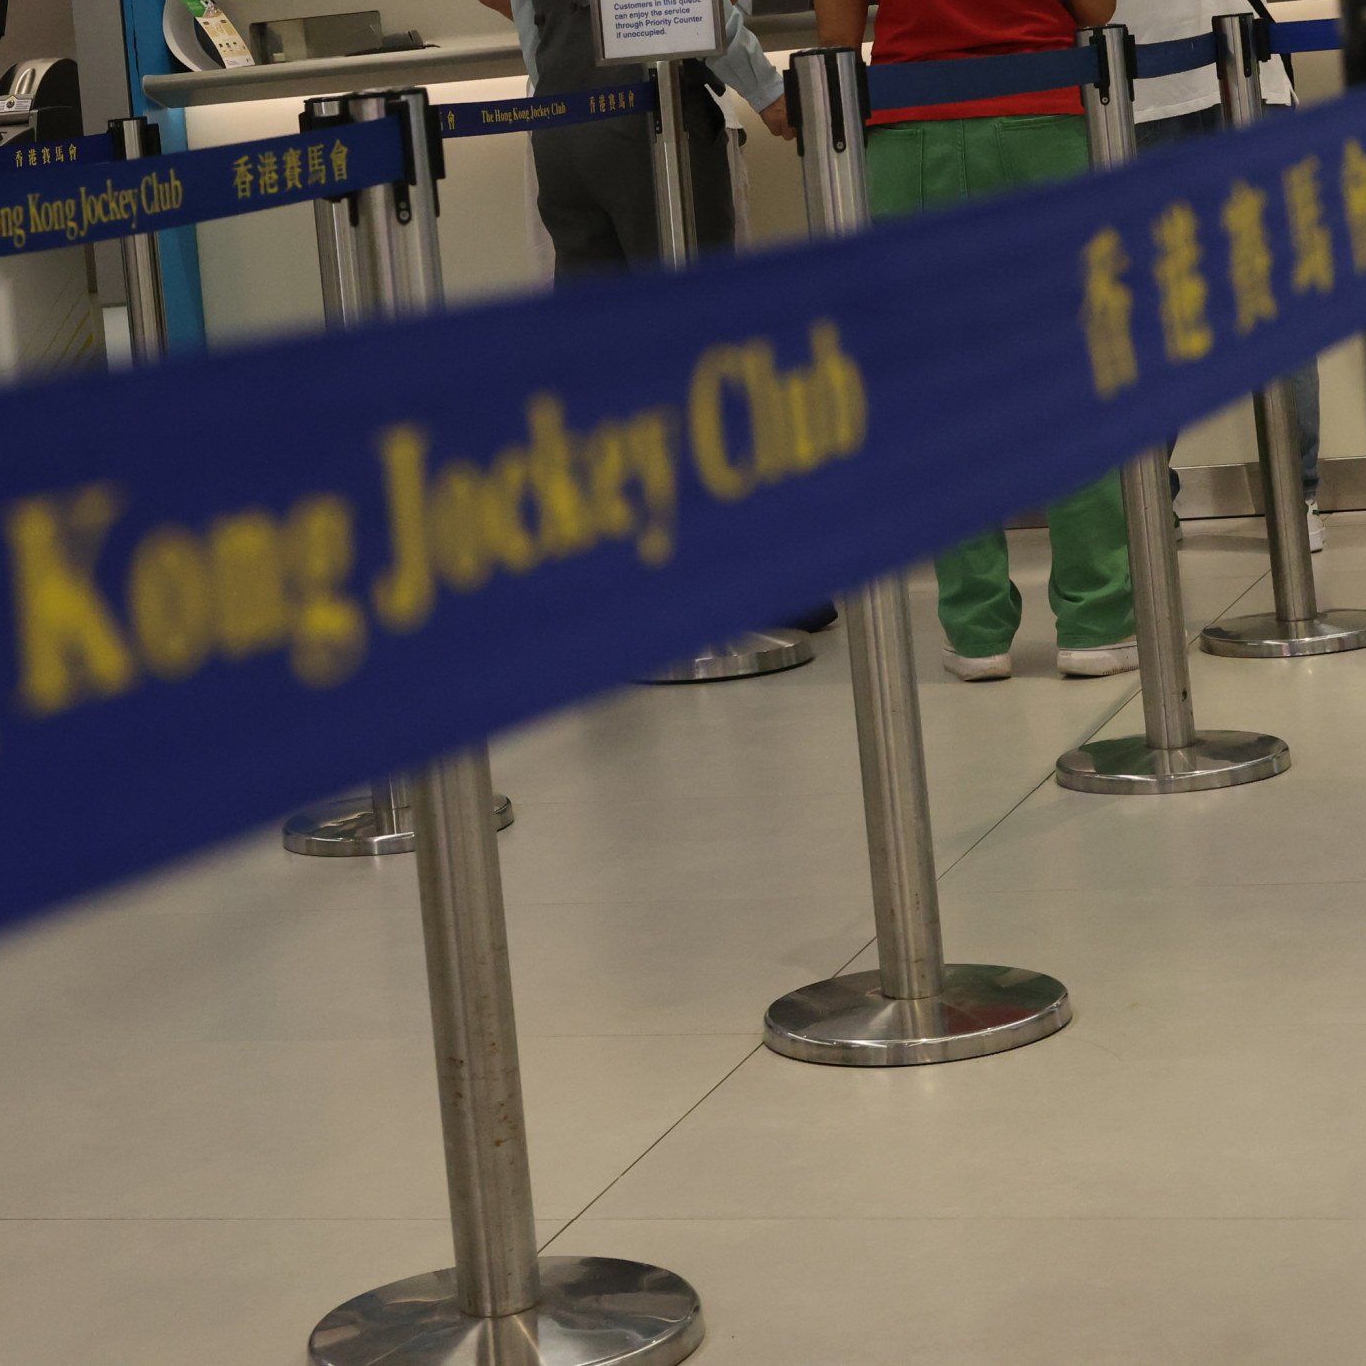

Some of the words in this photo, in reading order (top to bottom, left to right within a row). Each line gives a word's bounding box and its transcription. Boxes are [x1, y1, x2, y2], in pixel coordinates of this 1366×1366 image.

[614, 1, 653, 11] Customers
[654, 0, 662, 7] in
[615, 12, 628, 20] can
[629, 10, 649, 21] enjoy
[650, 9, 663, 17] the
[664, 7, 691, 16] service
[615, 20, 644, 30] through
[645, 18, 672, 27] Priority
[673, 15, 703, 24] Counter
[616, 31, 622, 39] if
[622, 28, 667, 39] unoccupied.
[481, 109, 495, 124] The
[495, 108, 513, 125] Hong
[513, 106, 530, 124] Kong
[530, 104, 551, 122] Jockey
[551, 102, 567, 117] Club
[14, 142, 79, 169] 香港賽馬會
[232, 138, 349, 201] 香港賽馬會
[27, 191, 79, 241] Kong
[79, 179, 140, 236] Jockey
[140, 167, 184, 216] Club
[2, 481, 368, 716] Kong
[372, 389, 678, 630] Jockey
[687, 320, 870, 501] Club
